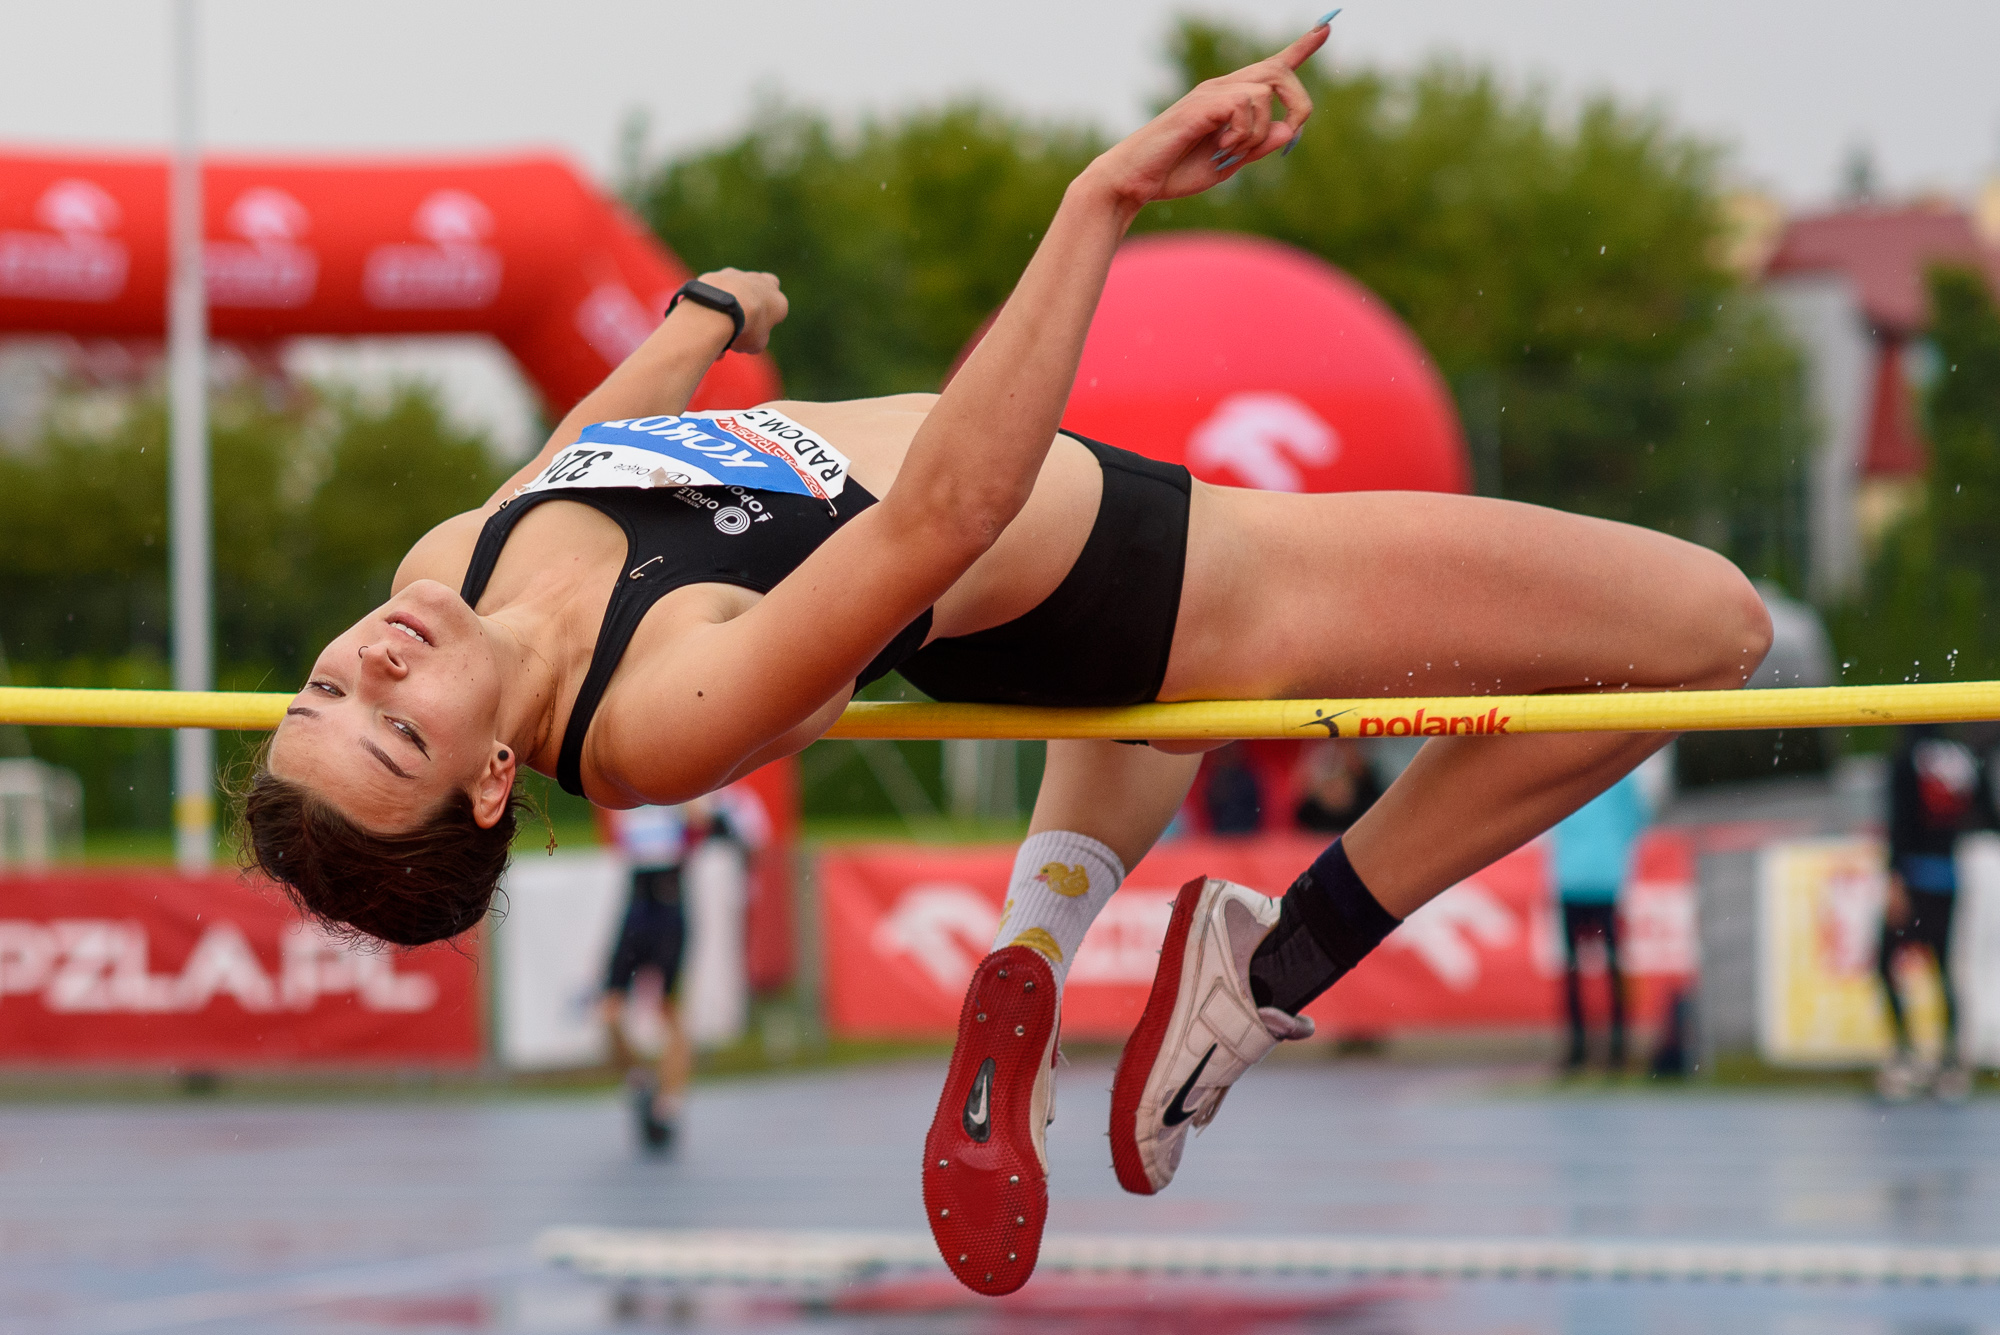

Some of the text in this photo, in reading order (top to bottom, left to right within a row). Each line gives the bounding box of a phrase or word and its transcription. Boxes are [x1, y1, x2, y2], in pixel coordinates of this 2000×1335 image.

[601, 415, 769, 467] KOKOT
[758, 417, 843, 482] RADOM
[678, 486, 719, 510] OPOLE
[1359, 707, 1511, 737] polanik
